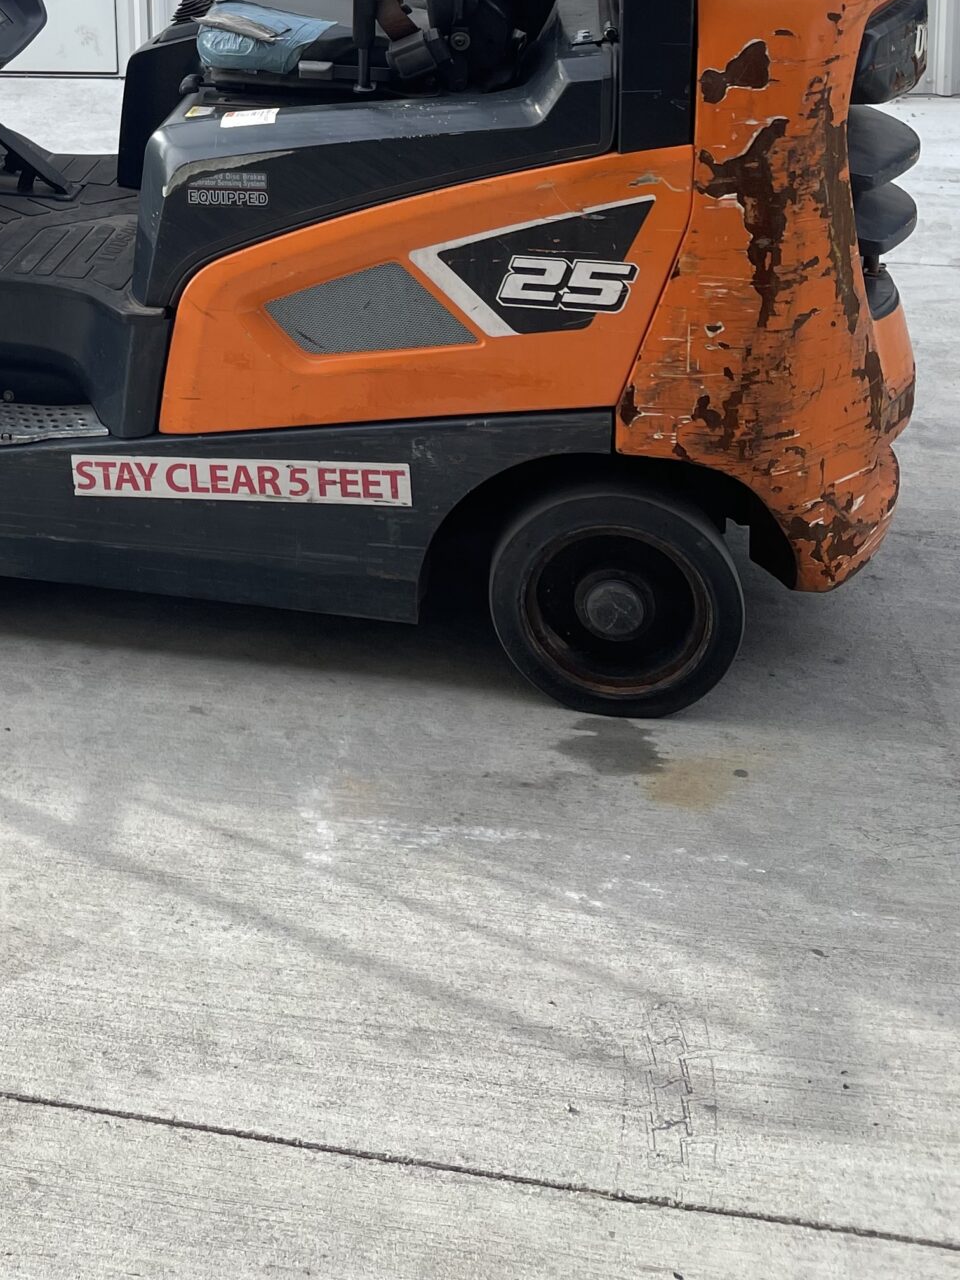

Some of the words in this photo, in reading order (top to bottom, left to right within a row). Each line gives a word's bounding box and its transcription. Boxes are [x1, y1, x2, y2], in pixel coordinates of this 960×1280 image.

[243, 172, 266, 181] Brakes
[188, 189, 269, 205] EQUIPPED
[496, 255, 640, 314] 25
[75, 461, 158, 492] STAY
[166, 463, 281, 496] CLEAR
[289, 468, 310, 497] 5
[318, 468, 406, 500] FEET
